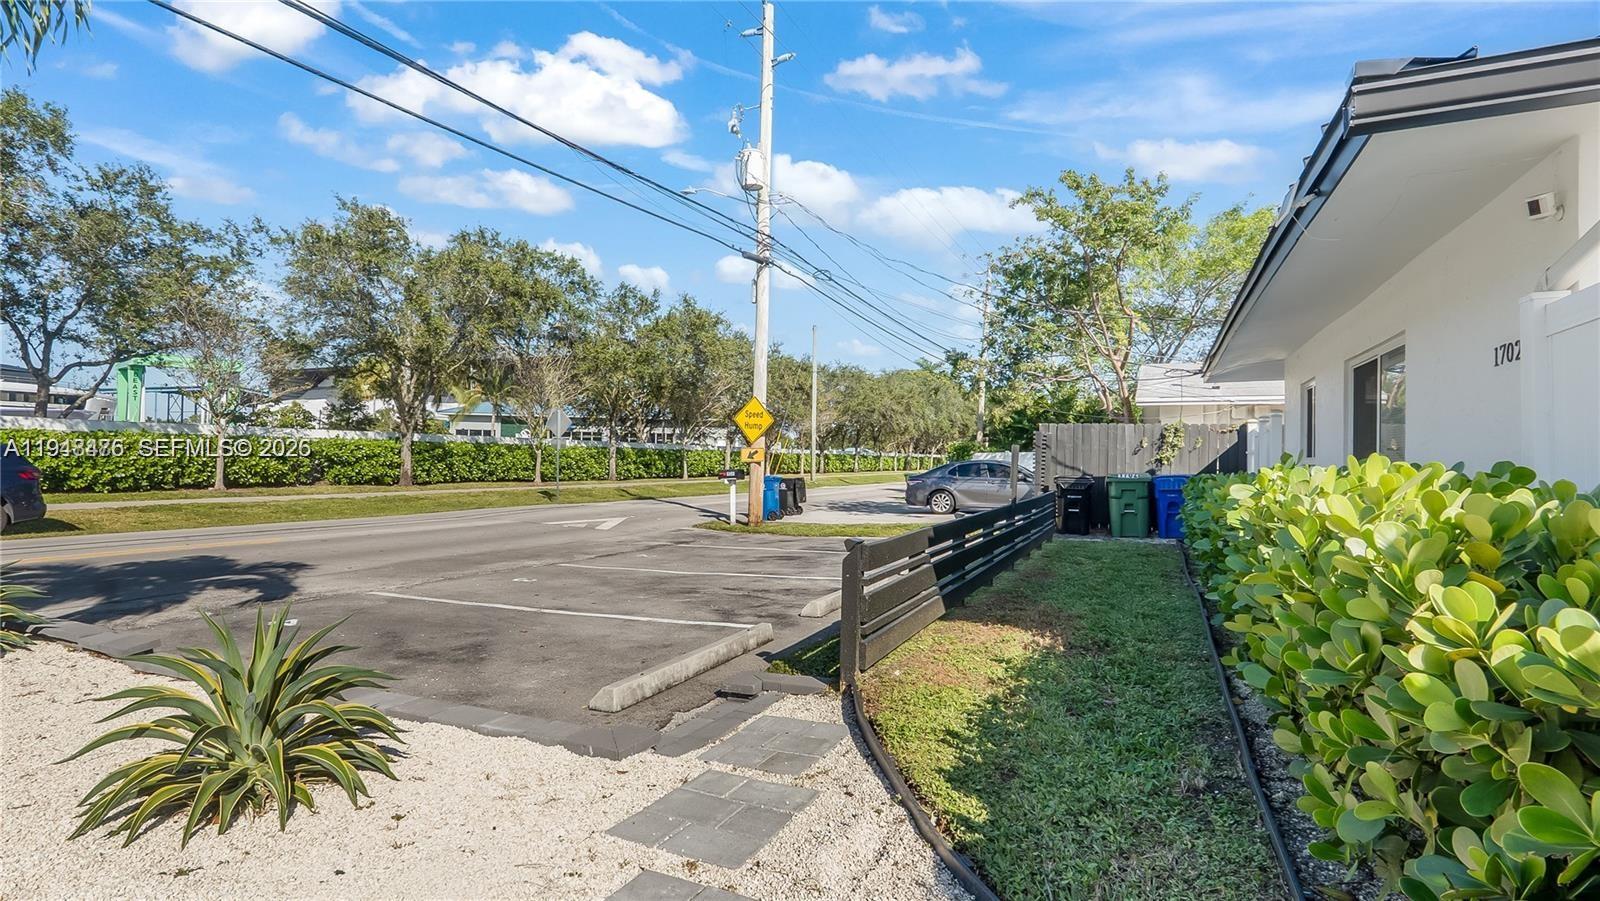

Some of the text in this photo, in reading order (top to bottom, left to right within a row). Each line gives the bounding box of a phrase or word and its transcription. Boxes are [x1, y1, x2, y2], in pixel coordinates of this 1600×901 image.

[1494, 340, 1520, 367] 1702
[744, 410, 763, 420] Speed
[744, 422, 763, 431] Hump
